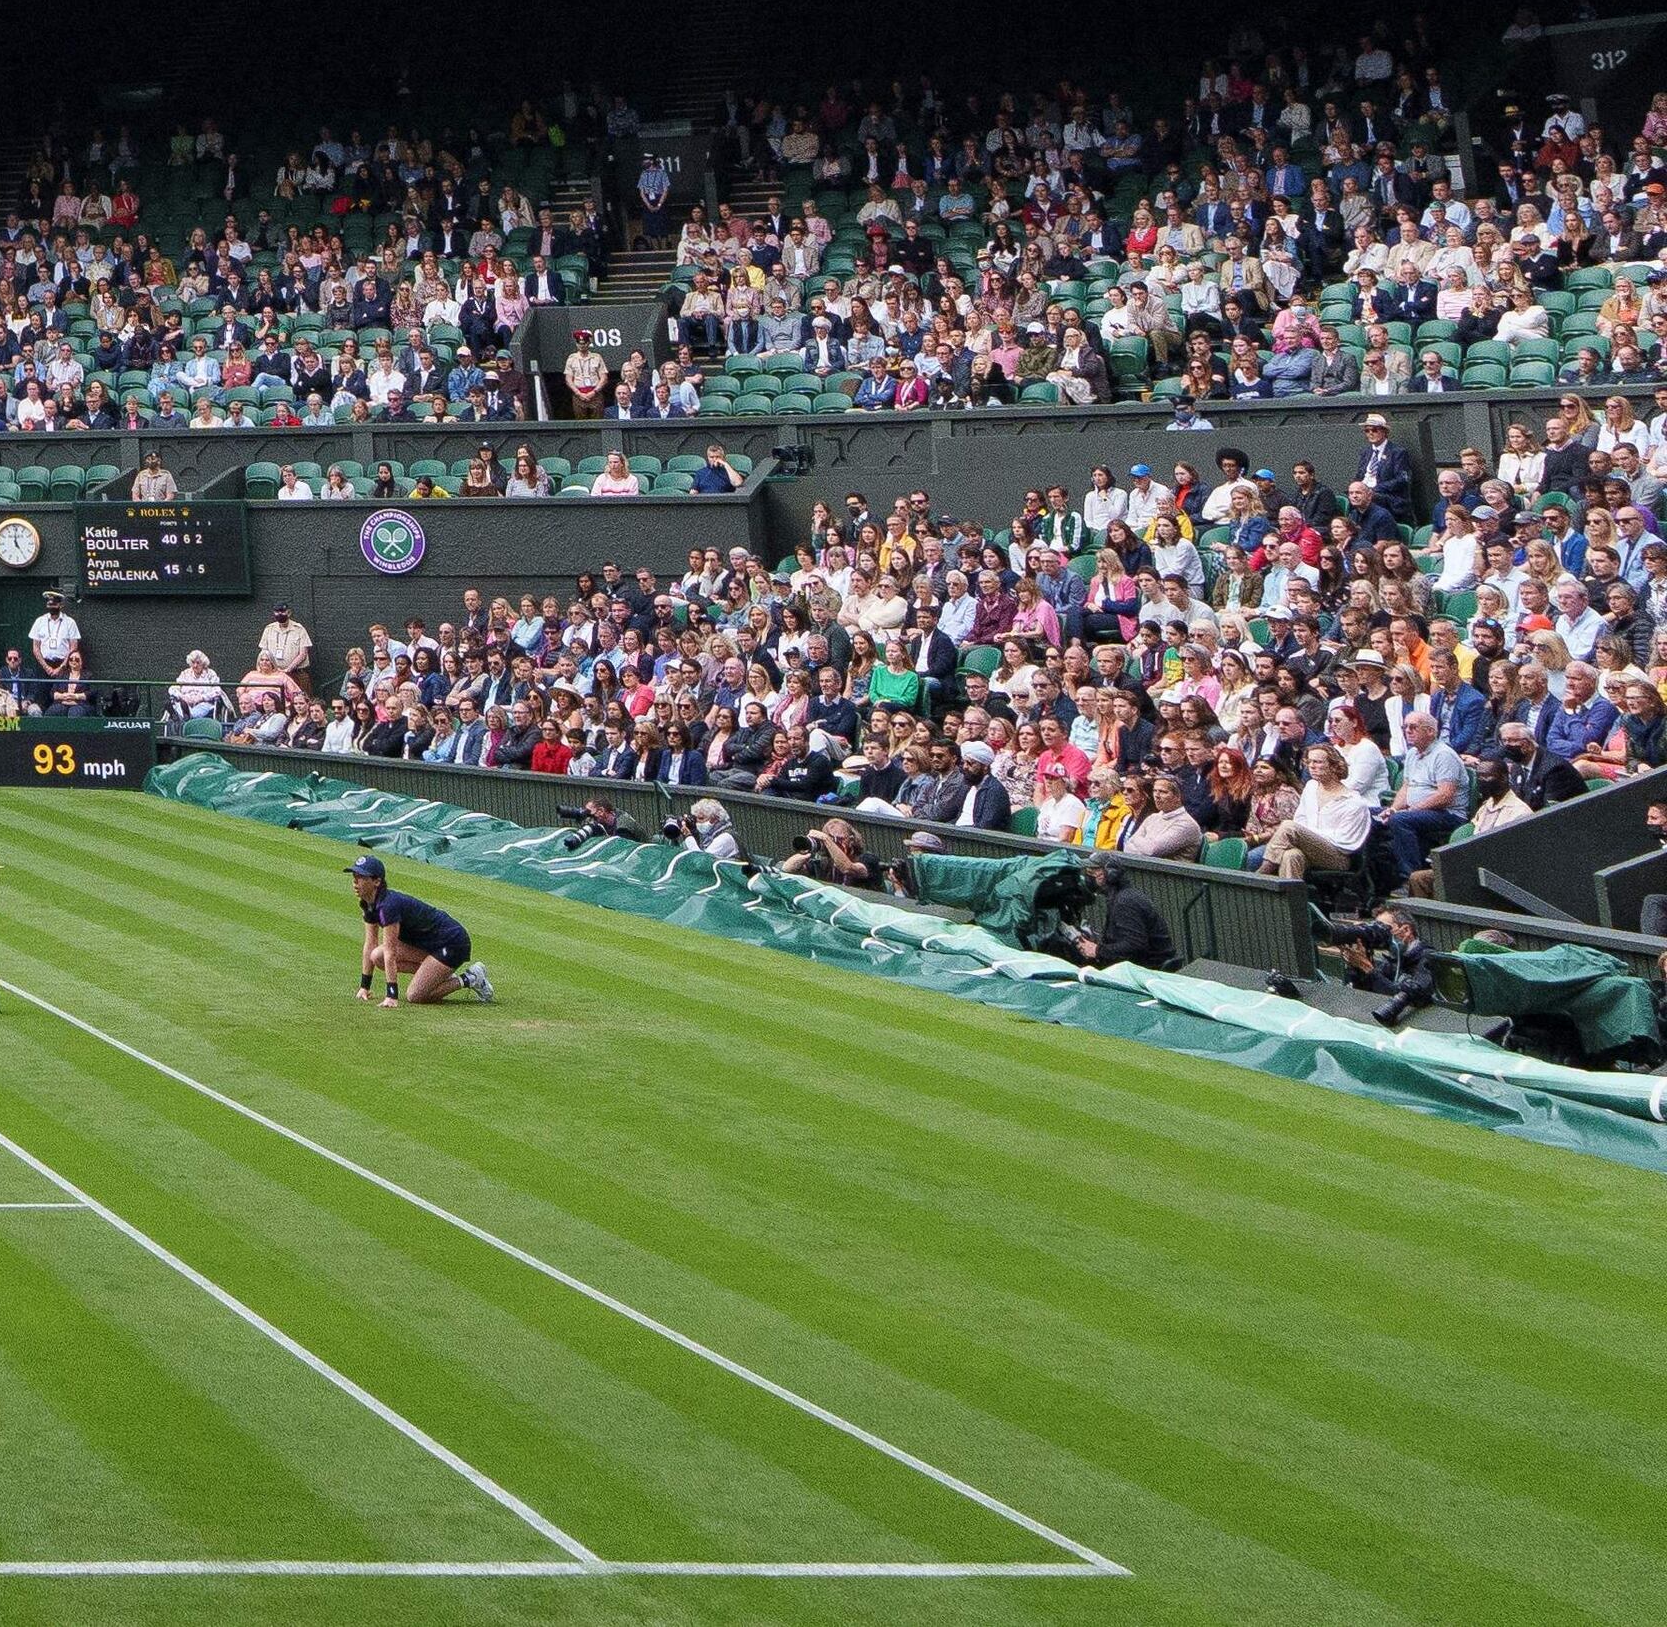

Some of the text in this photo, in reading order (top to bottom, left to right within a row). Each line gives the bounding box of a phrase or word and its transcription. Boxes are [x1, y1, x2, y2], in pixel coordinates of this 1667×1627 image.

[85, 526, 118, 538] Katie
[86, 534, 203, 550] BOULTER 40 6 2
[87, 558, 120, 572] Aryna
[87, 570, 159, 581] SABALENKA
[164, 564, 180, 575] 15
[198, 564, 206, 574] 5
[33, 743, 126, 779] 93 mph
